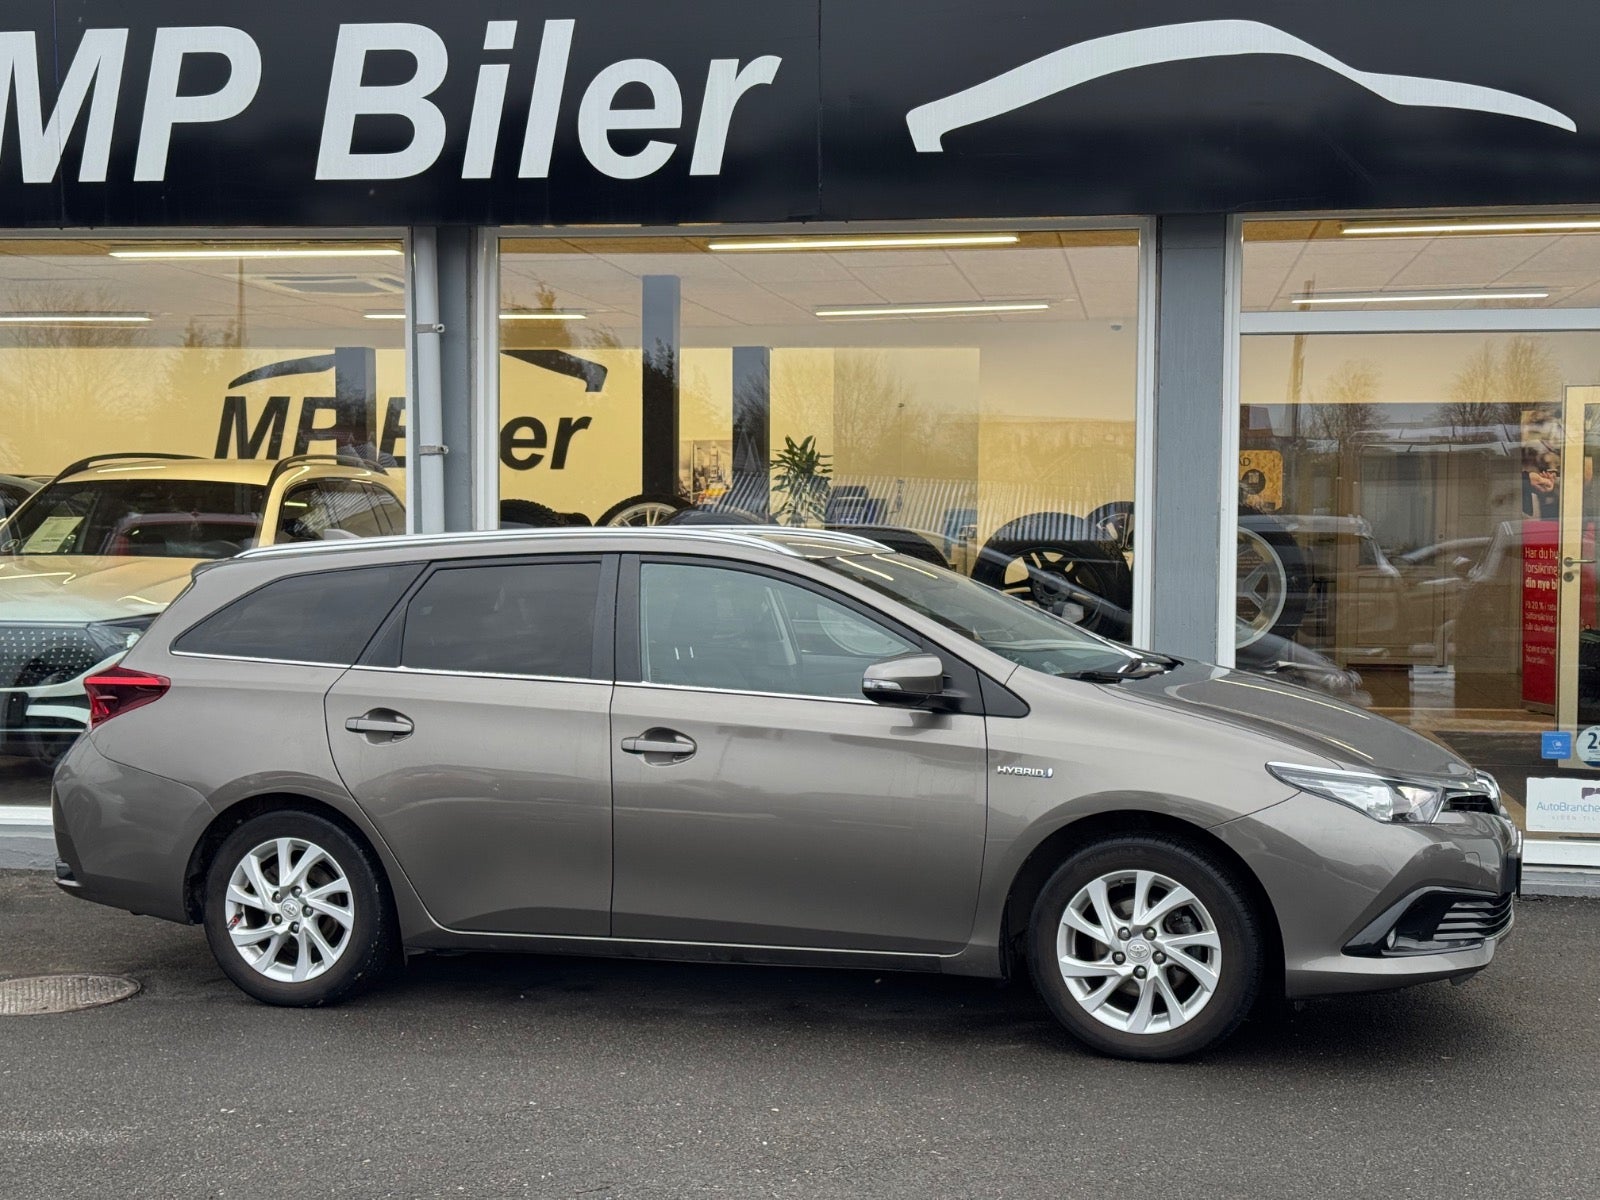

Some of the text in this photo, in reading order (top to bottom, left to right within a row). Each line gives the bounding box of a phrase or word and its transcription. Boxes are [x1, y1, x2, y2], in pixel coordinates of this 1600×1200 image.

[0, 19, 783, 182] MP Biler
[1525, 547, 1537, 558] Har
[997, 766, 1044, 776] HYBRID
